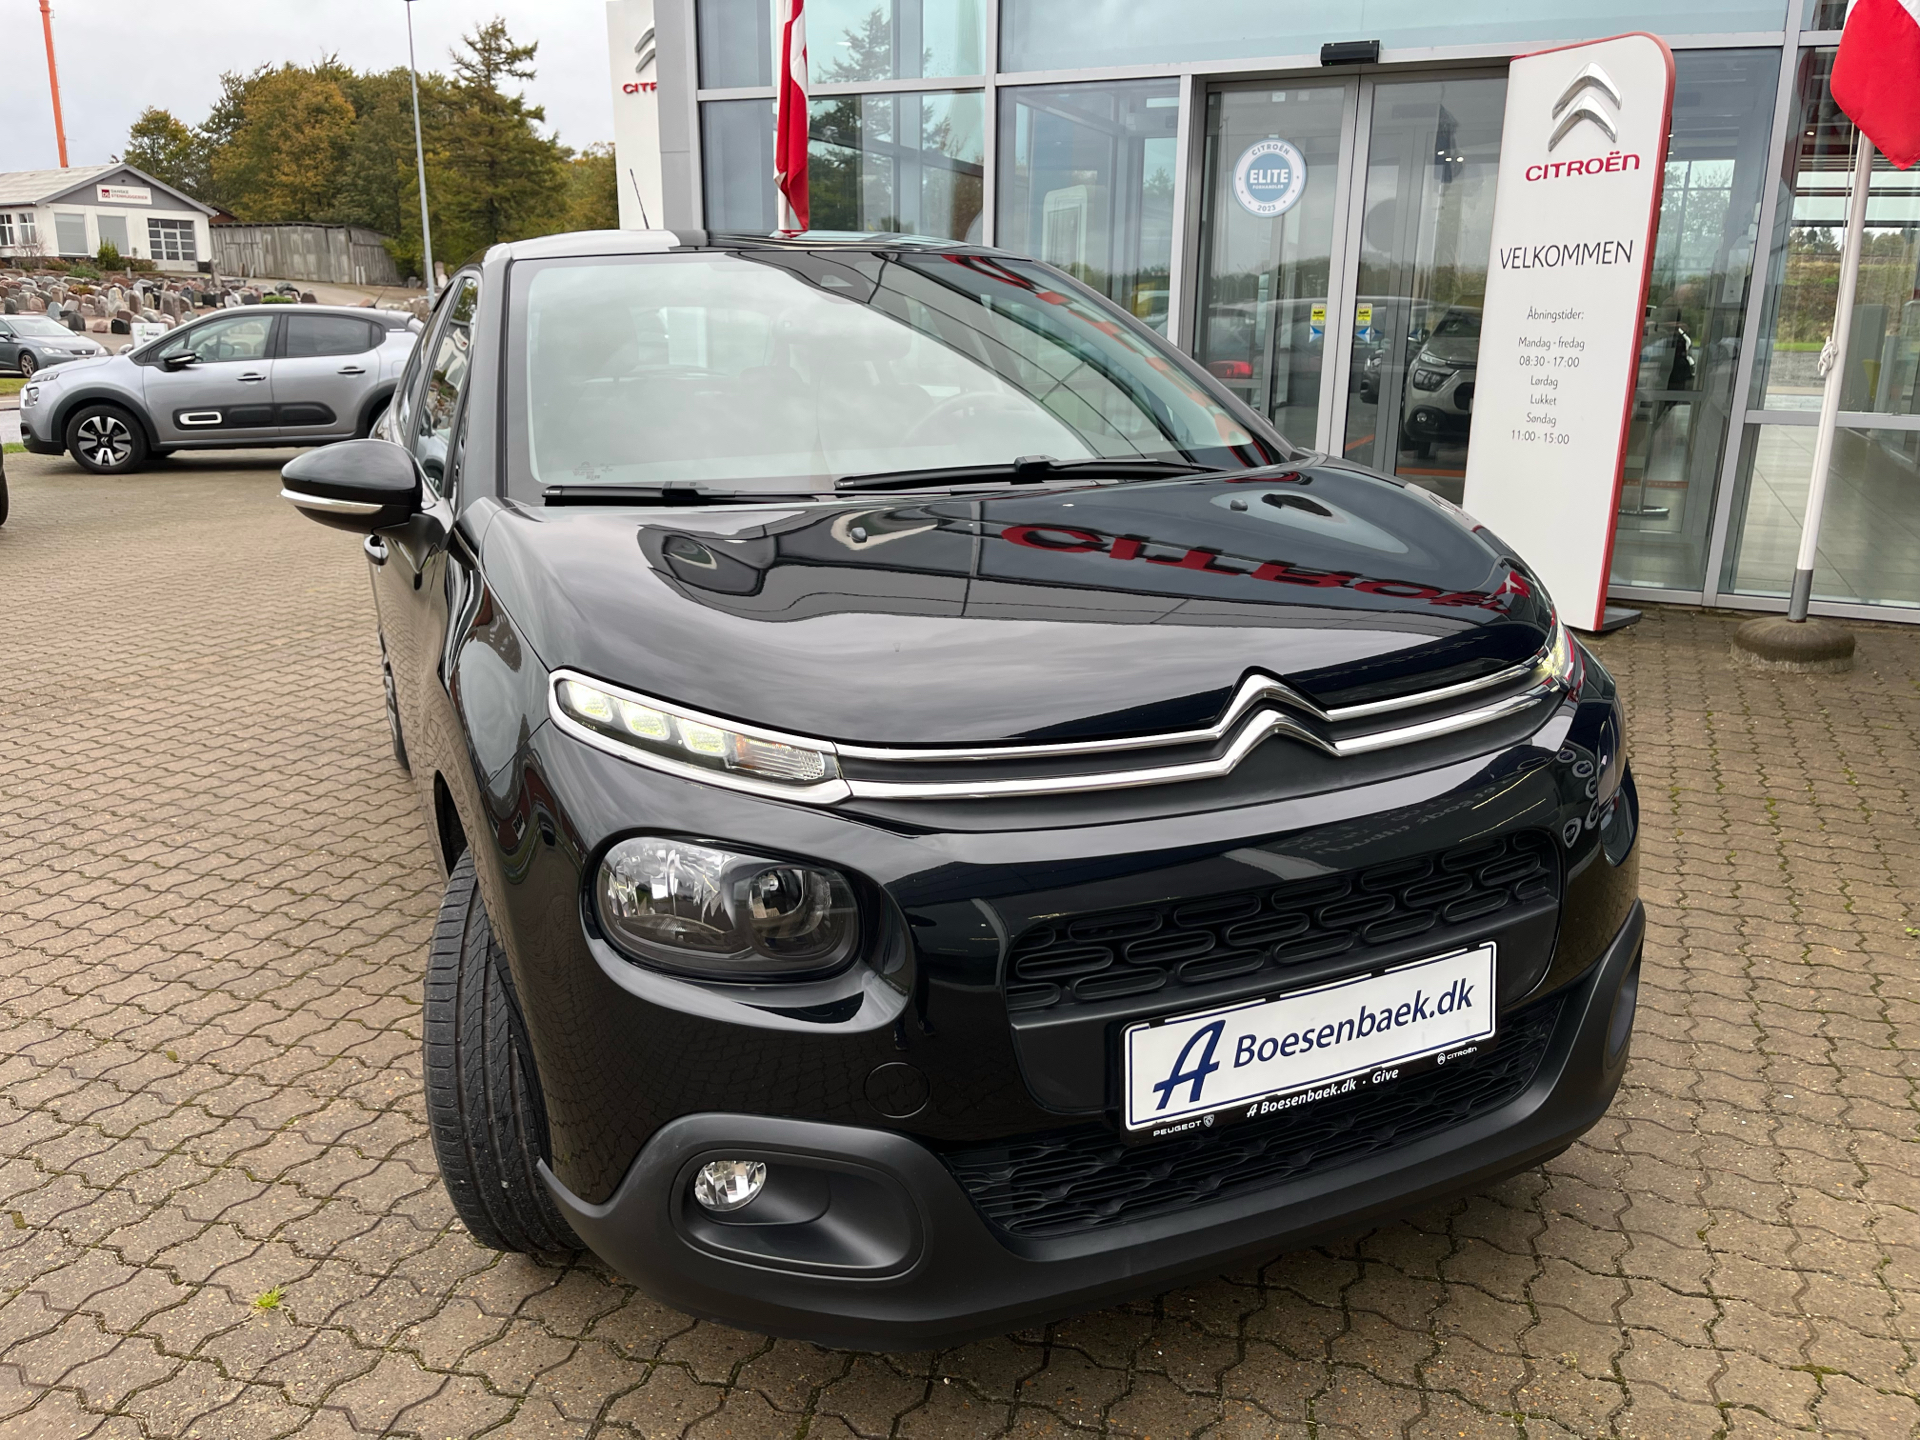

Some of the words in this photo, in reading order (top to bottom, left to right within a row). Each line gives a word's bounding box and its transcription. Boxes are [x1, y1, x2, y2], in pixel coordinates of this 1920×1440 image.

[1252, 143, 1290, 156] CITROËN
[1249, 168, 1289, 184] ELITE
[1257, 204, 1276, 212] 2023
[1500, 240, 1633, 269] VELKOMMEN
[1526, 306, 1584, 323] Åbningstider:
[1518, 336, 1551, 351] Mandag
[1558, 336, 1585, 352] fredag
[1519, 355, 1545, 367] 08:30
[1553, 356, 1580, 368] 17:00
[1530, 375, 1558, 390] Lørdag
[1530, 393, 1557, 406] Lukket
[1526, 412, 1557, 428] Søndag
[1512, 430, 1535, 442] 11:00
[1544, 432, 1570, 445] 15:00
[1233, 977, 1475, 1068] Boesenbaek.dk
[1260, 1078, 1357, 1115] Boesenbaek.dk
[1372, 1067, 1399, 1084] Give
[1153, 1120, 1202, 1137] PEUGEOT
